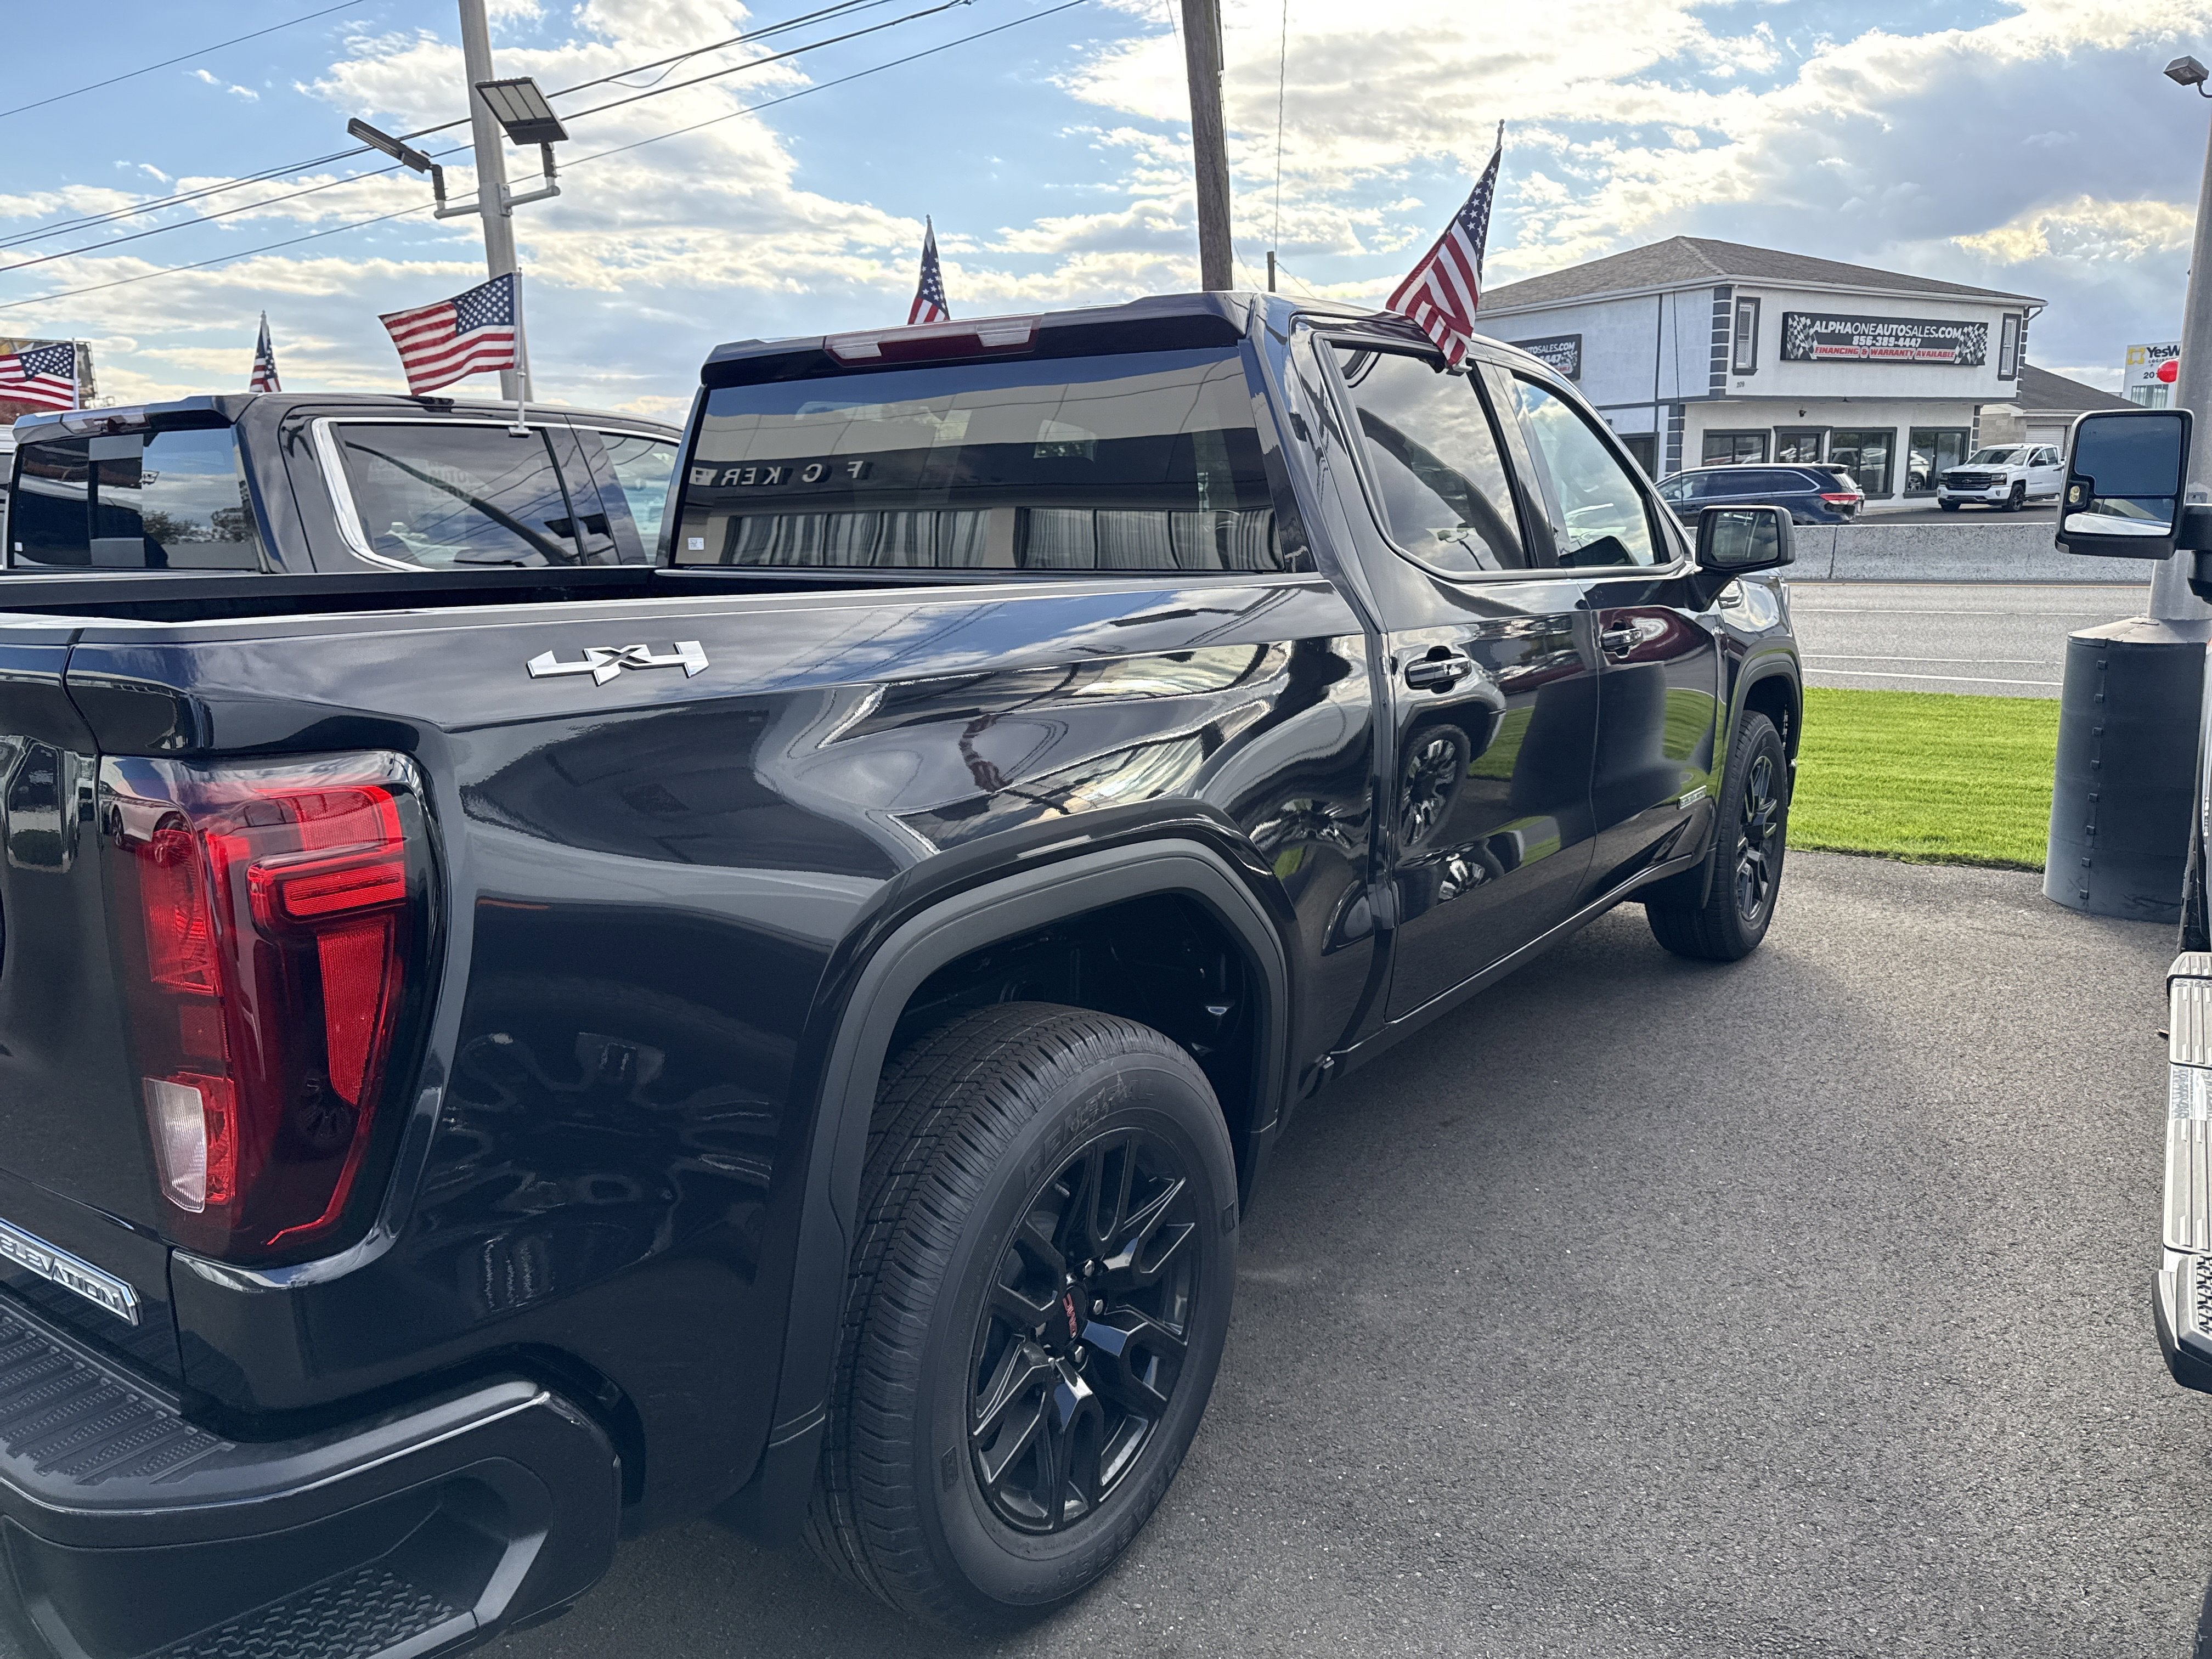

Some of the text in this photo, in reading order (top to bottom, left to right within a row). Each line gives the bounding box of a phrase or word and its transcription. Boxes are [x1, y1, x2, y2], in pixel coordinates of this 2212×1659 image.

[1813, 320, 1962, 338] ALPHAONEAUTOSALES.COM
[1852, 335, 1922, 347] 856-389-4447
[1814, 346, 1860, 355] FINANCING
[0, 1232, 127, 1316] ELEVATION
[1062, 1293, 1078, 1339] GMC
